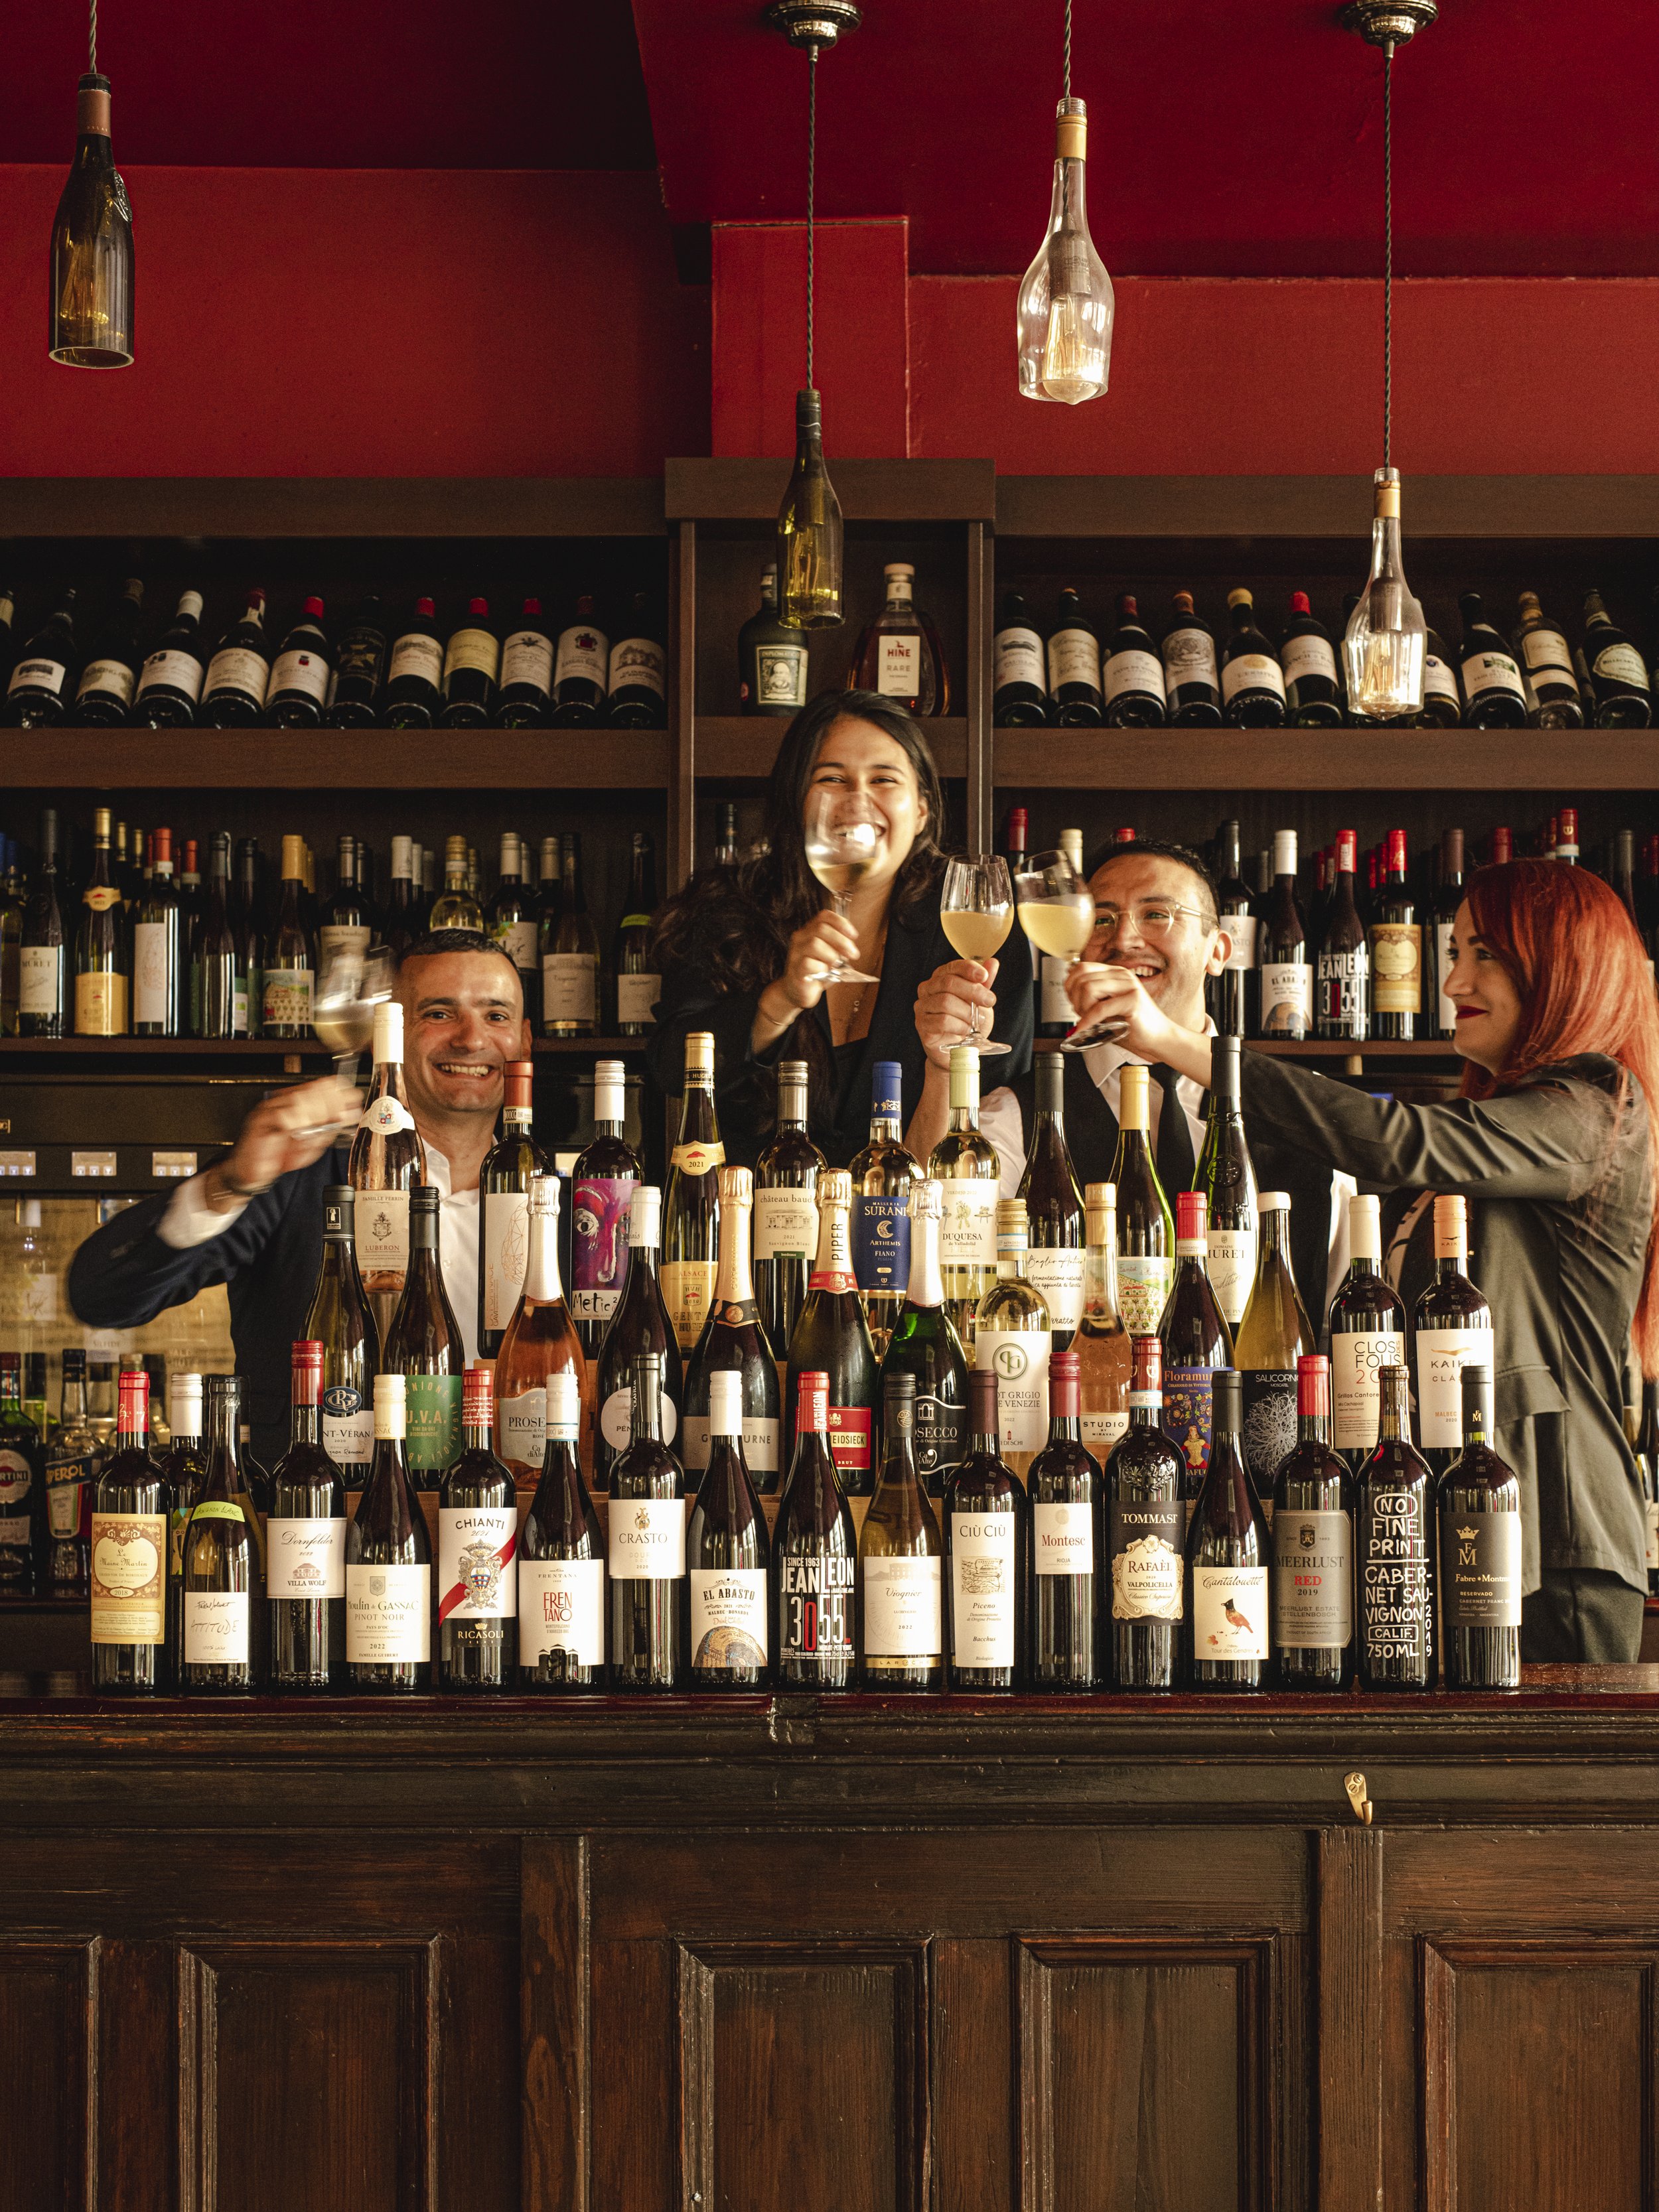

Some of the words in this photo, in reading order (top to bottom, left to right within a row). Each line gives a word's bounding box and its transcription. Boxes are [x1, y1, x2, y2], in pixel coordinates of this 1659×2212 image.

[887, 649, 911, 657] HINE
[760, 1194, 789, 1204] château
[865, 1206, 907, 1217] SURANI
[831, 1223, 843, 1261] PIPER
[1027, 1255, 1056, 1269] Baglio
[573, 1292, 611, 1312] Metic
[1354, 1340, 1396, 1354] CLOS
[1356, 1354, 1401, 1369] FOUS
[1008, 1391, 1041, 1399] GRIGIO
[405, 1409, 447, 1424] U.V.A.
[508, 1417, 545, 1427] PROSE
[0, 1471, 27, 1482] RTINI
[221, 1505, 240, 1517] BLANC
[1380, 1497, 1407, 1514] NO
[455, 1517, 505, 1530] CHIANTI
[1121, 1513, 1179, 1525] TOMMASI
[1372, 1517, 1420, 1538] FINE
[281, 1531, 334, 1549] Dornfelder
[618, 1533, 668, 1545] CRASTO
[116, 1548, 126, 1556] Le
[1369, 1539, 1425, 1558] PRINT
[1464, 1543, 1473, 1554] F
[787, 1557, 804, 1567] SINCE
[805, 1557, 820, 1567] 1963
[1277, 1556, 1344, 1568] MEERLUST
[1458, 1548, 1478, 1565] M
[1128, 1559, 1173, 1574] RAFAÈL
[781, 1556, 820, 1593] JEAN
[820, 1556, 855, 1594] LEON
[1202, 1574, 1264, 1590] Cantalouette
[1294, 1575, 1323, 1586] RED
[1364, 1566, 1433, 1586] CABER-
[1455, 1573, 1477, 1583] Fabre
[703, 1590, 715, 1601] EL
[718, 1588, 756, 1601] ABASTO
[885, 1586, 922, 1600] Viognier
[1366, 1586, 1395, 1605] NET
[1402, 1586, 1434, 1605] SAU-
[348, 1597, 370, 1610] Moulin
[378, 1600, 419, 1611] GASSAC
[543, 1592, 573, 1609] FREN
[543, 1608, 573, 1622] TANO
[1365, 1605, 1423, 1625] VIGNON
[190, 1618, 240, 1635] ATTITUDE
[458, 1629, 504, 1639] RICASOLI
[1374, 1629, 1413, 1639] CALIF.
